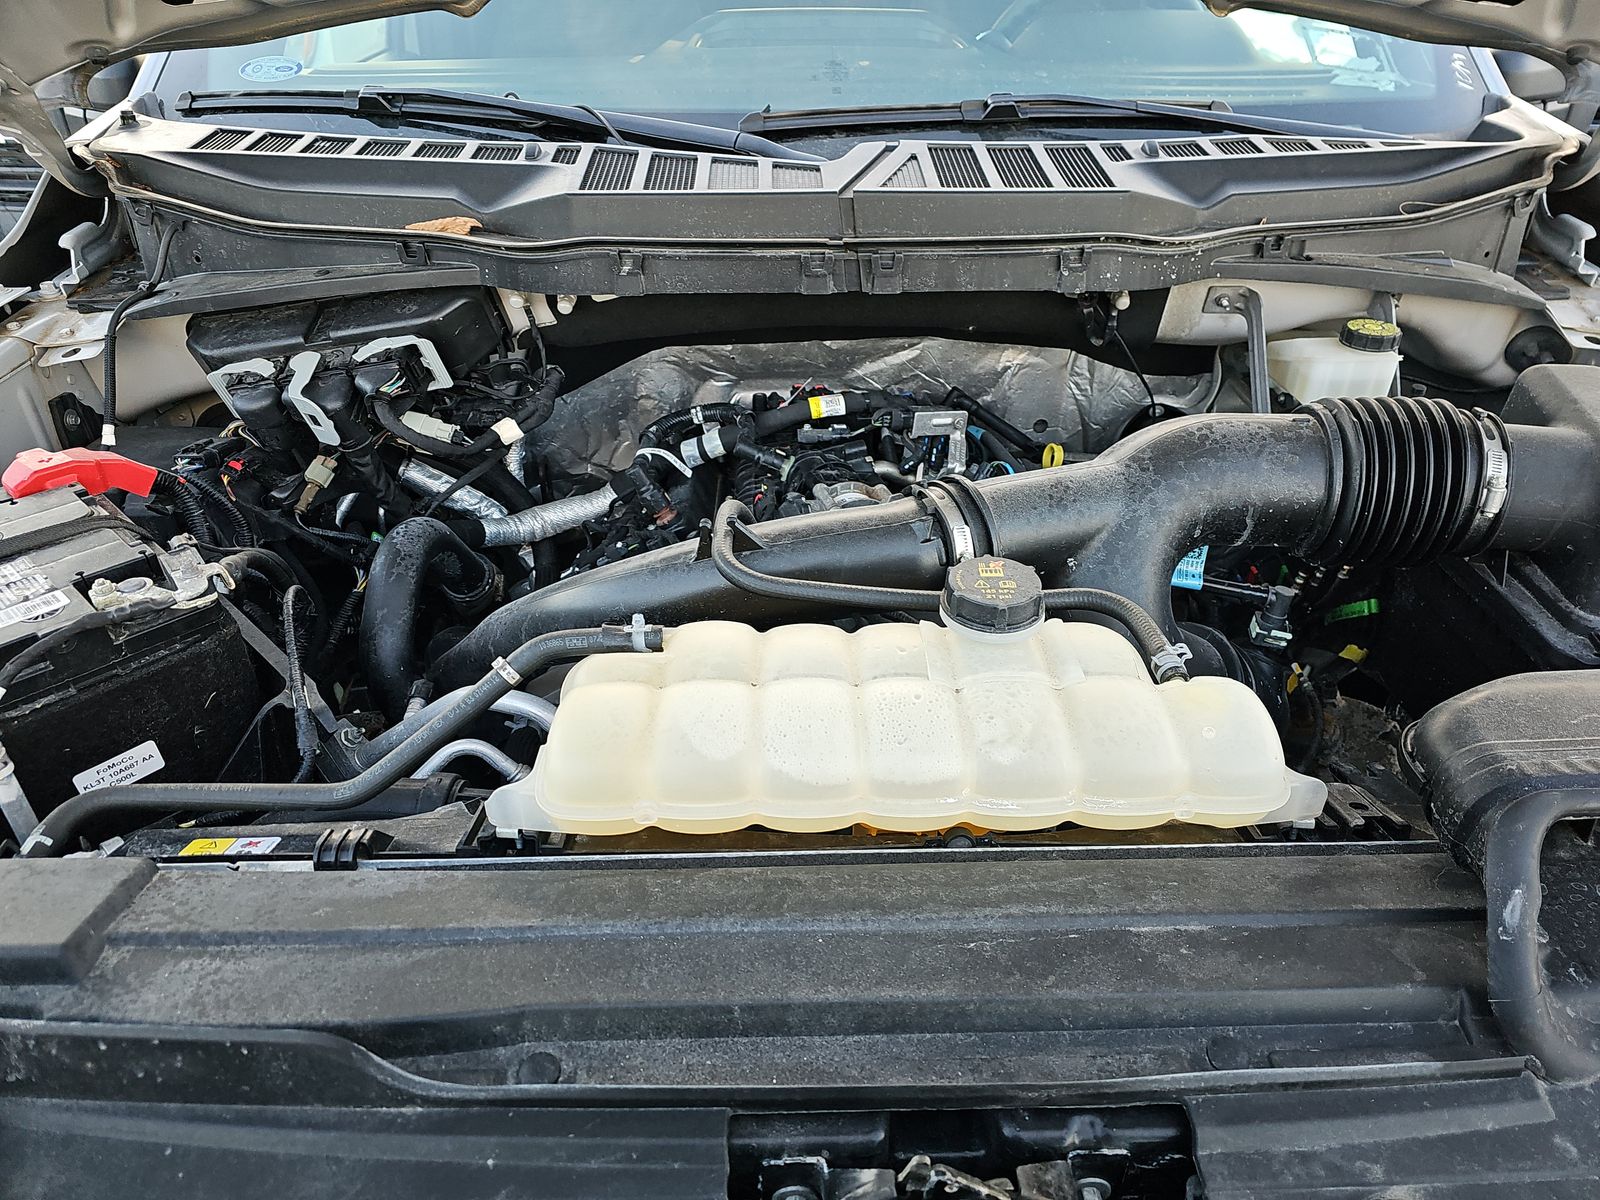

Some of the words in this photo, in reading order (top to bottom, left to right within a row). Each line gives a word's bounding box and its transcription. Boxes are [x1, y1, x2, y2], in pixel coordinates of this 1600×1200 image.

[83, 776, 106, 791] KL3T
[109, 760, 139, 778] 10A687
[142, 753, 155, 763] AA
[96, 755, 134, 775] FoMoCo
[109, 771, 137, 787] C500L
